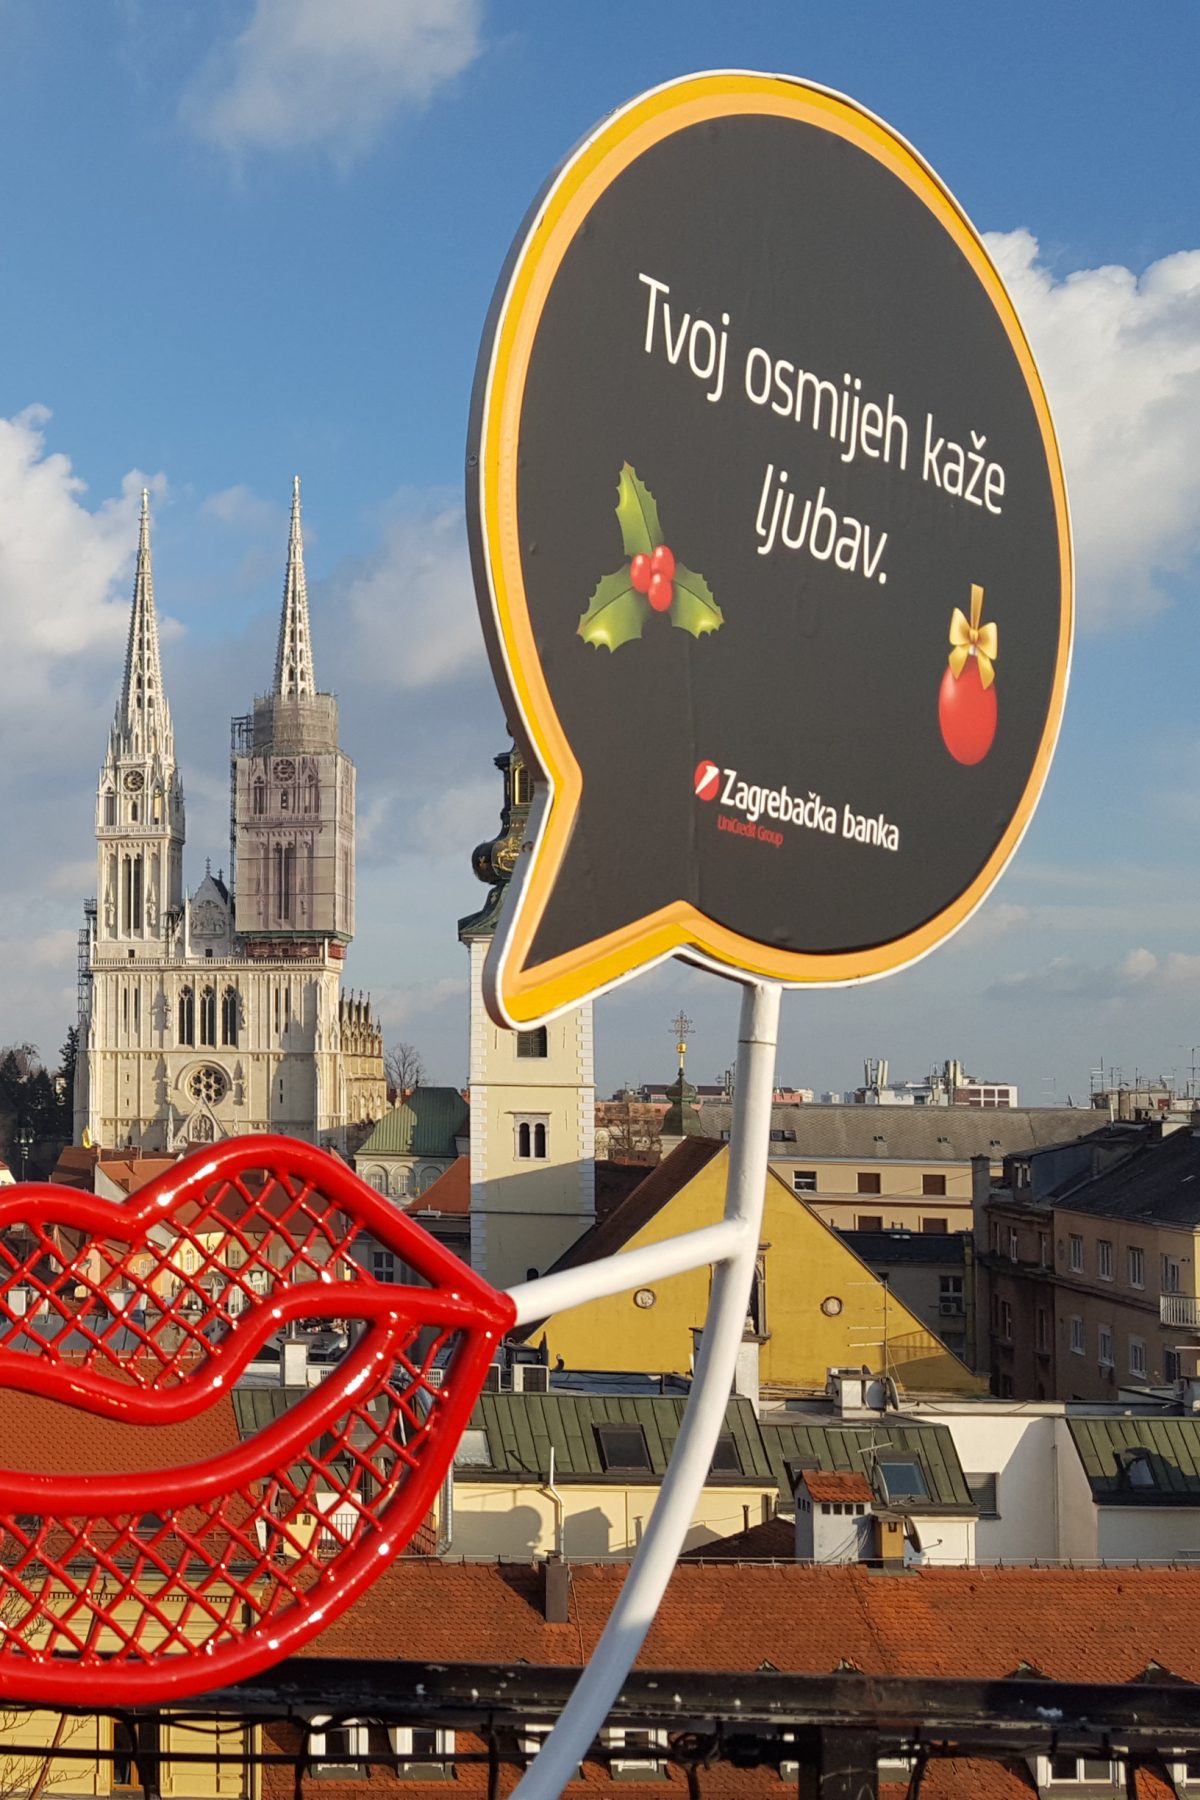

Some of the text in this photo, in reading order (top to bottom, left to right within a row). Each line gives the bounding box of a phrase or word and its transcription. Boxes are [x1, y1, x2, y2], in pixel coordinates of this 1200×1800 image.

[639, 273, 1005, 514] Tvoj osmijeh kaže
[756, 464, 887, 584] ljubav.
[717, 815, 783, 847] UniCredit Group
[720, 769, 899, 851] Zagrebačka banka
